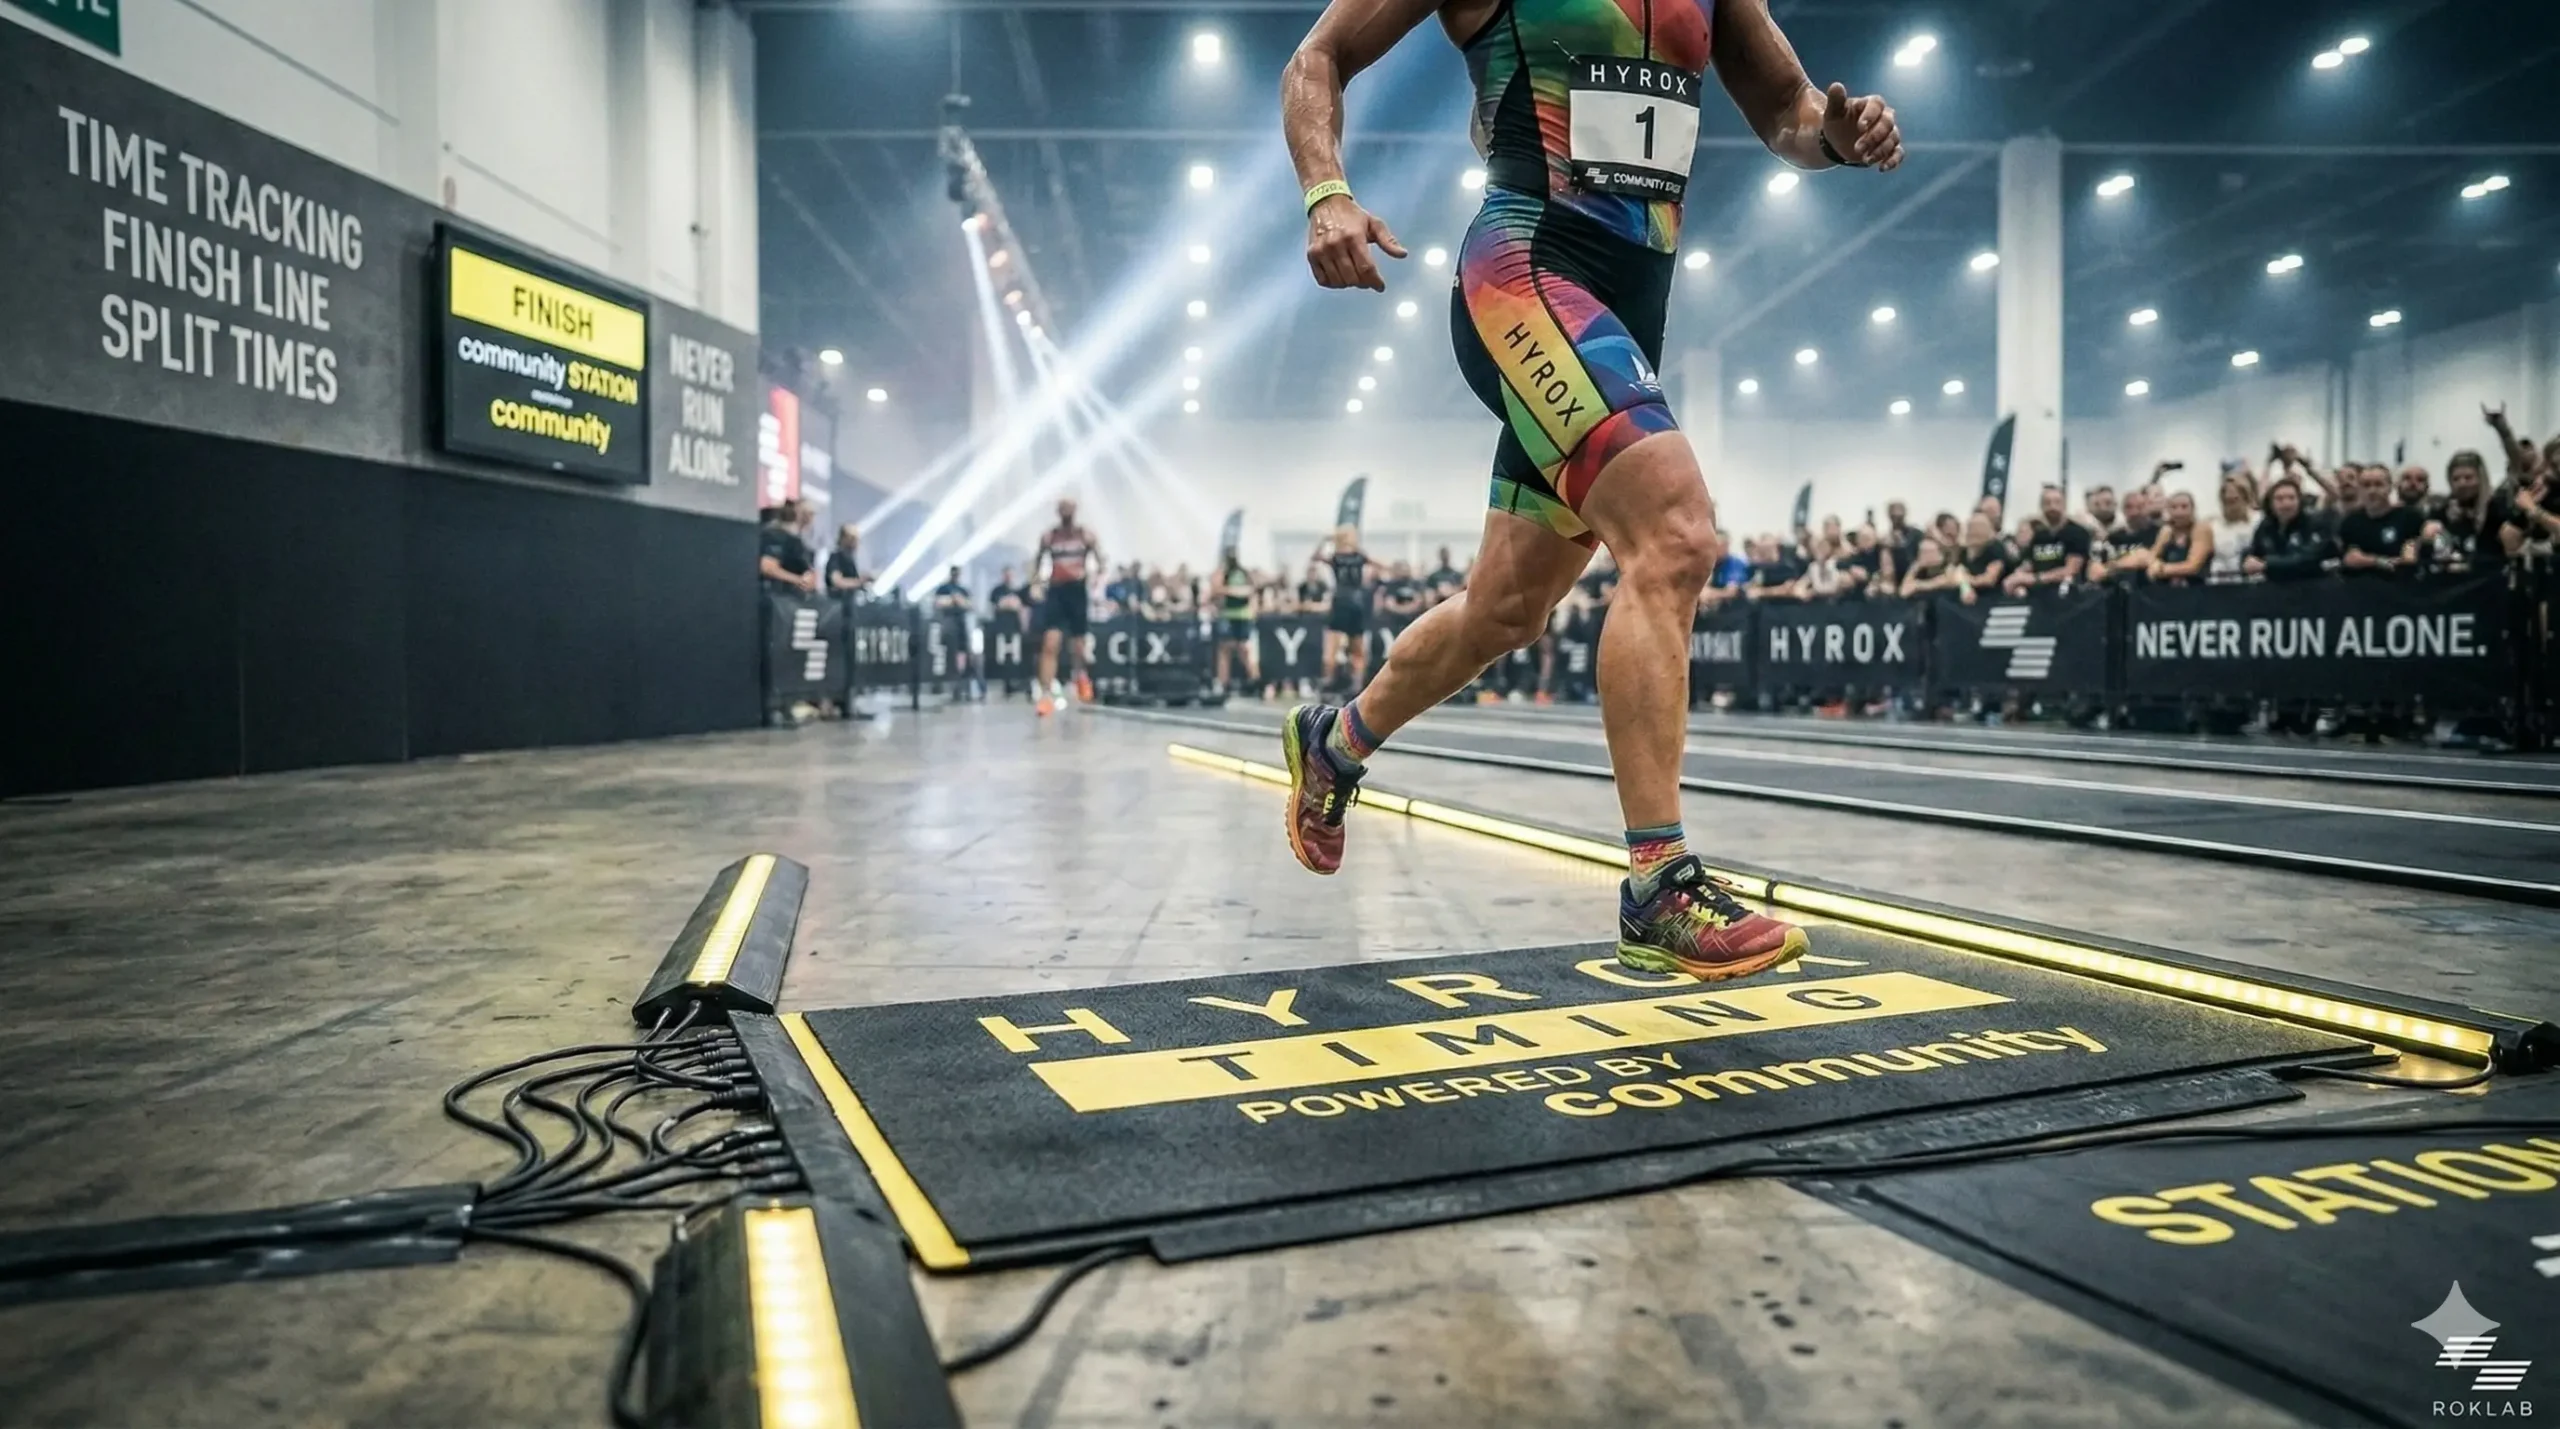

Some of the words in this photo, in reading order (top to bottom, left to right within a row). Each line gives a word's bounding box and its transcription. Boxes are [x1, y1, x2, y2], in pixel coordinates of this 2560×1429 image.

[1590, 64, 1687, 96] HYROX
[1635, 105, 1655, 161] 1
[58, 104, 169, 206] TIME
[179, 151, 363, 271] TRACKING
[103, 207, 240, 306] FINISH
[253, 254, 330, 332] LINE
[512, 284, 595, 342] FINISH
[101, 293, 220, 378] SPLIT
[229, 324, 338, 405] TIMES
[458, 336, 567, 391] community
[567, 361, 639, 405] STATION
[669, 333, 735, 394] NEVER
[1503, 321, 1585, 428] HYROX
[490, 398, 612, 456] community
[681, 387, 725, 437] RUN
[667, 432, 740, 486] ALONE.
[1770, 622, 1906, 663] HYROX
[2136, 619, 2242, 659] NEVER
[2249, 617, 2326, 658] RUN
[2334, 612, 2488, 658] ALONE.
[1178, 987, 1882, 1083] TIMING
[1236, 1069, 1592, 1125] POWERED
[1595, 1050, 1684, 1077] BY
[1543, 1025, 2110, 1118] community
